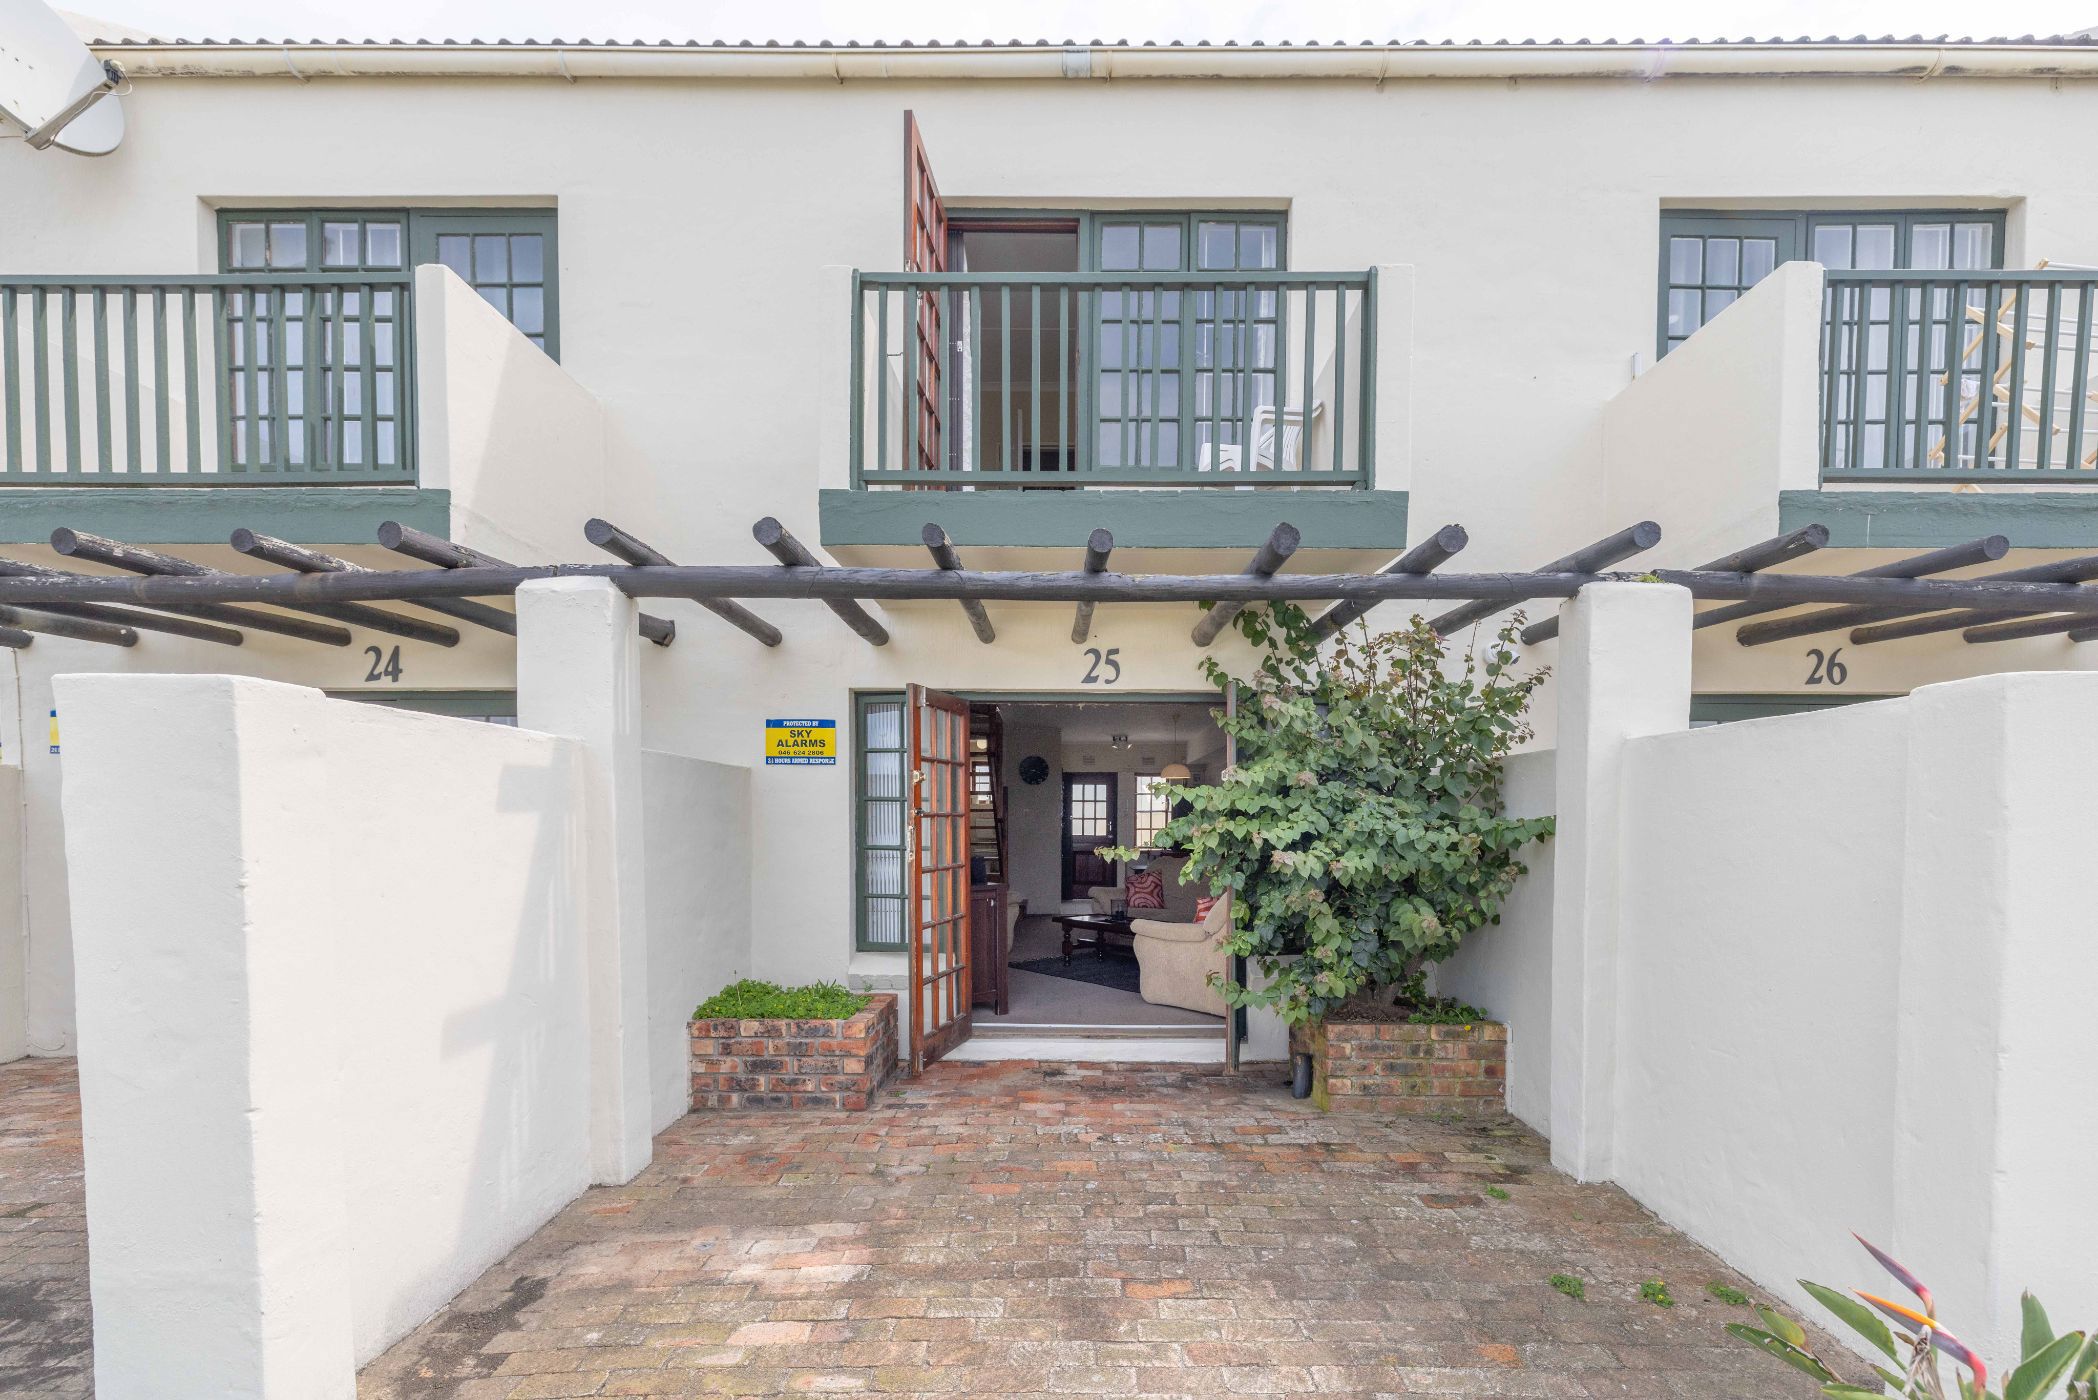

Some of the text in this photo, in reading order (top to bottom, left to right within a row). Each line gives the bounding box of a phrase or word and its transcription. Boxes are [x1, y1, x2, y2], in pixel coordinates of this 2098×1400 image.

[364, 645, 403, 682] 24
[1081, 648, 1120, 684] 25
[1805, 647, 1847, 685] 26
[776, 739, 826, 748] ALARMS
[789, 729, 813, 739] SKY
